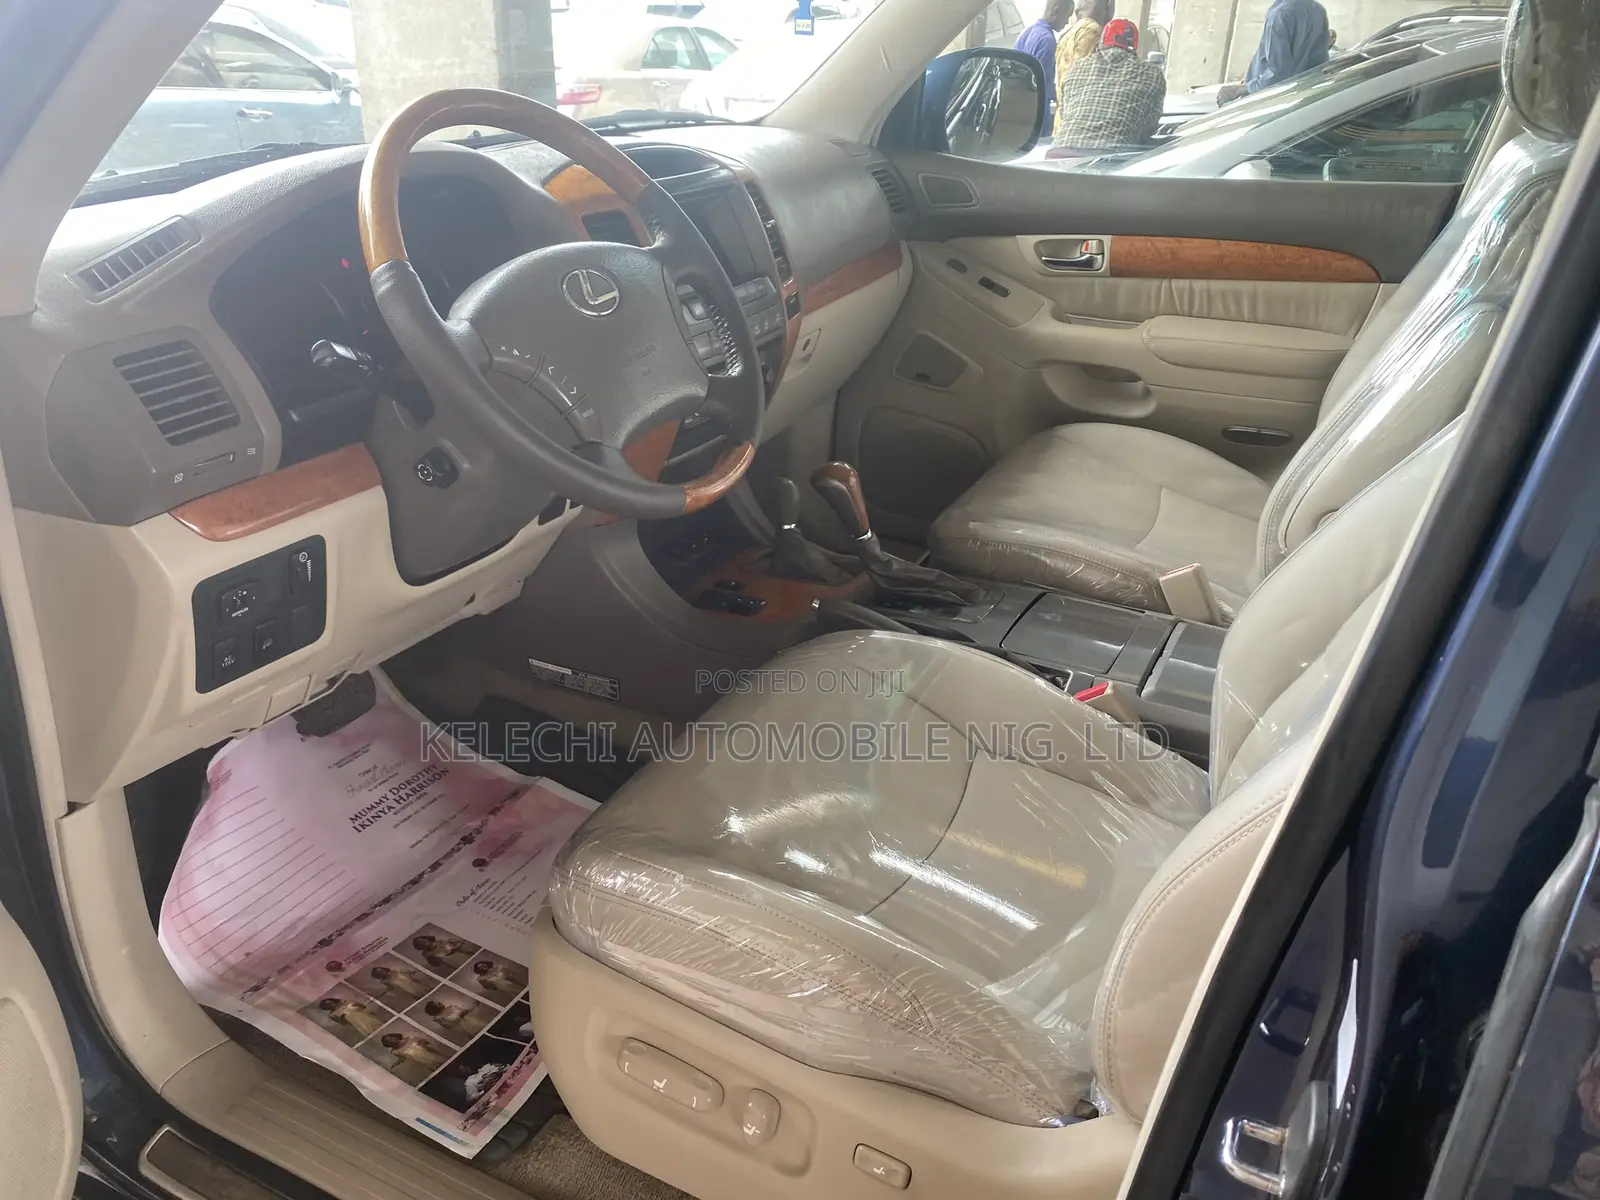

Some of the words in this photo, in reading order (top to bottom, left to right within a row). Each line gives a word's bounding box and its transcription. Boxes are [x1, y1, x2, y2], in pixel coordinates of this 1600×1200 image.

[348, 792, 390, 825] MUMMY
[388, 763, 439, 796] DOROTHY
[351, 805, 396, 834] IKINYA
[393, 767, 450, 806] HARRISON
